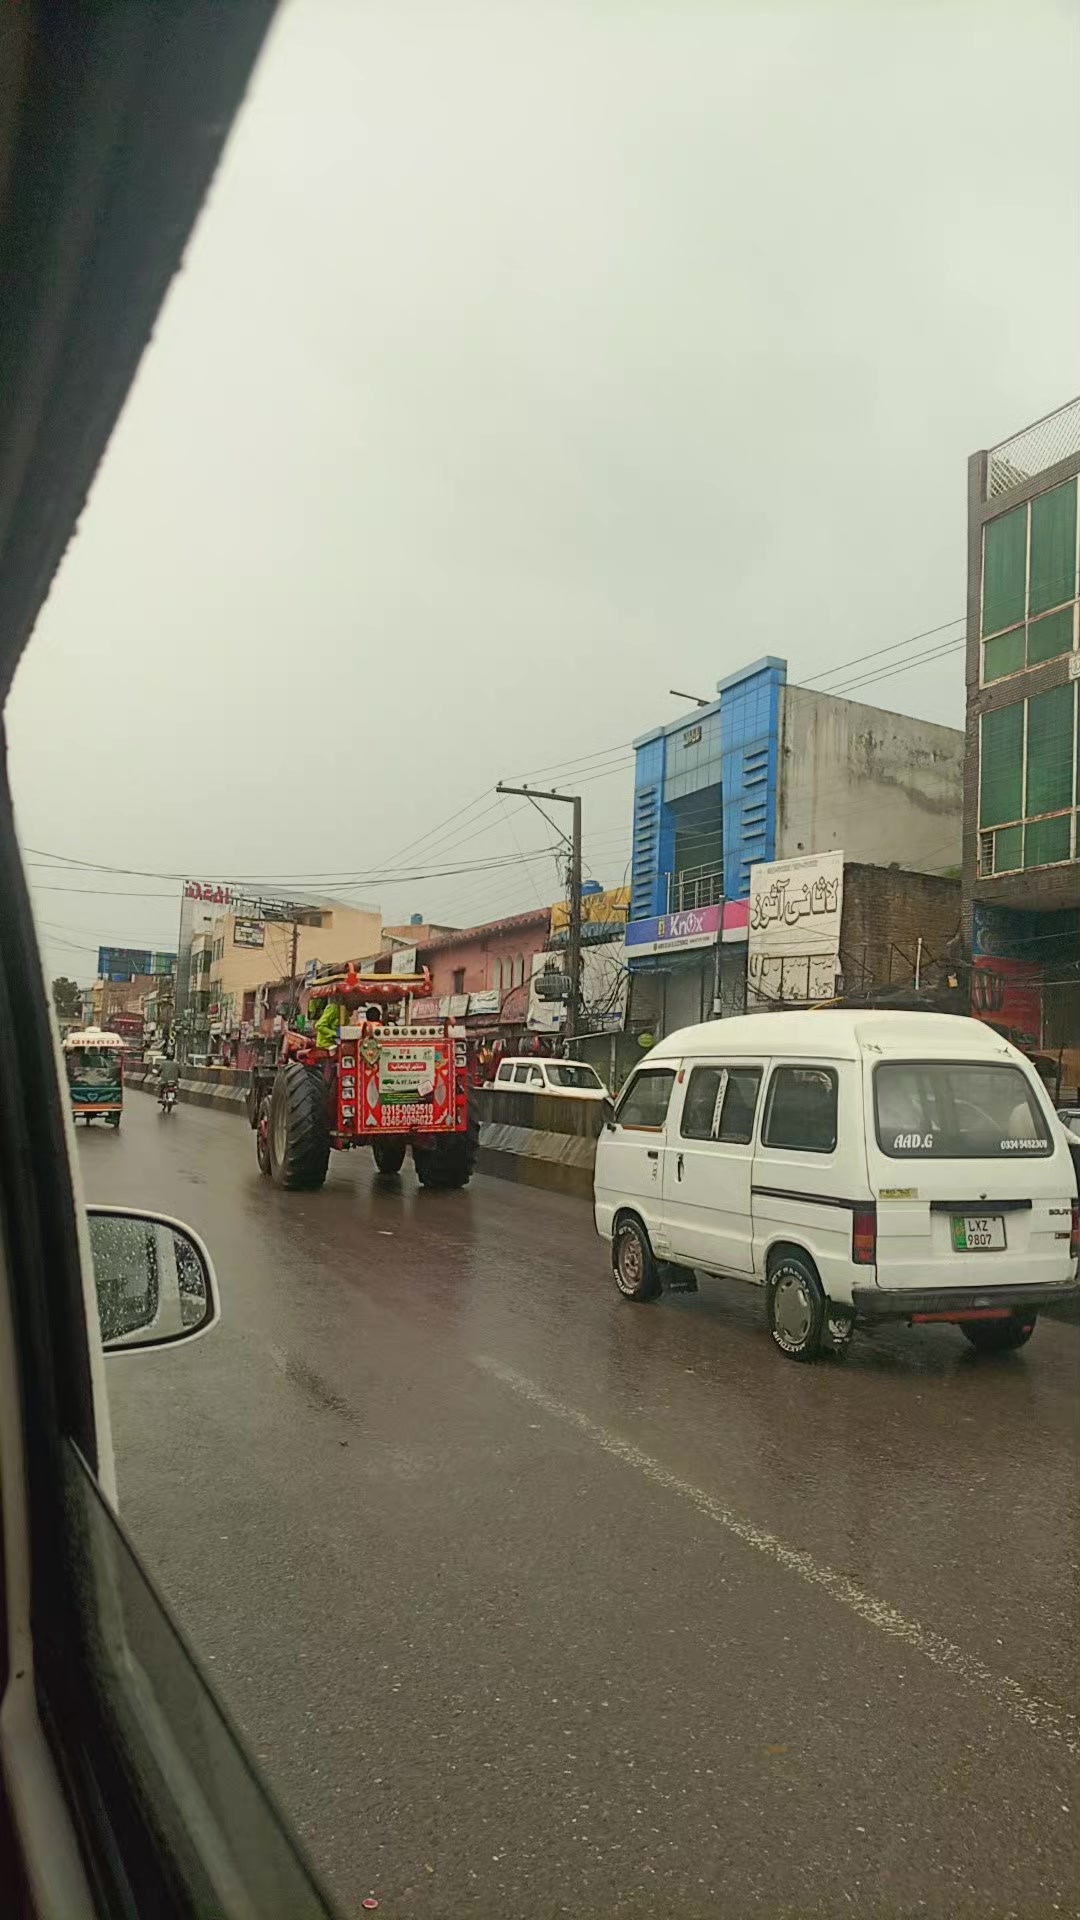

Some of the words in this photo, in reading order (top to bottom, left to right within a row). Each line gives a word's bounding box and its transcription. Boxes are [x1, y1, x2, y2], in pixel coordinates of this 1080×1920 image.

[784, 876, 839, 925] لاثانی
[968, 1219, 988, 1232] LXZ
[967, 1233, 992, 1246] 9807
